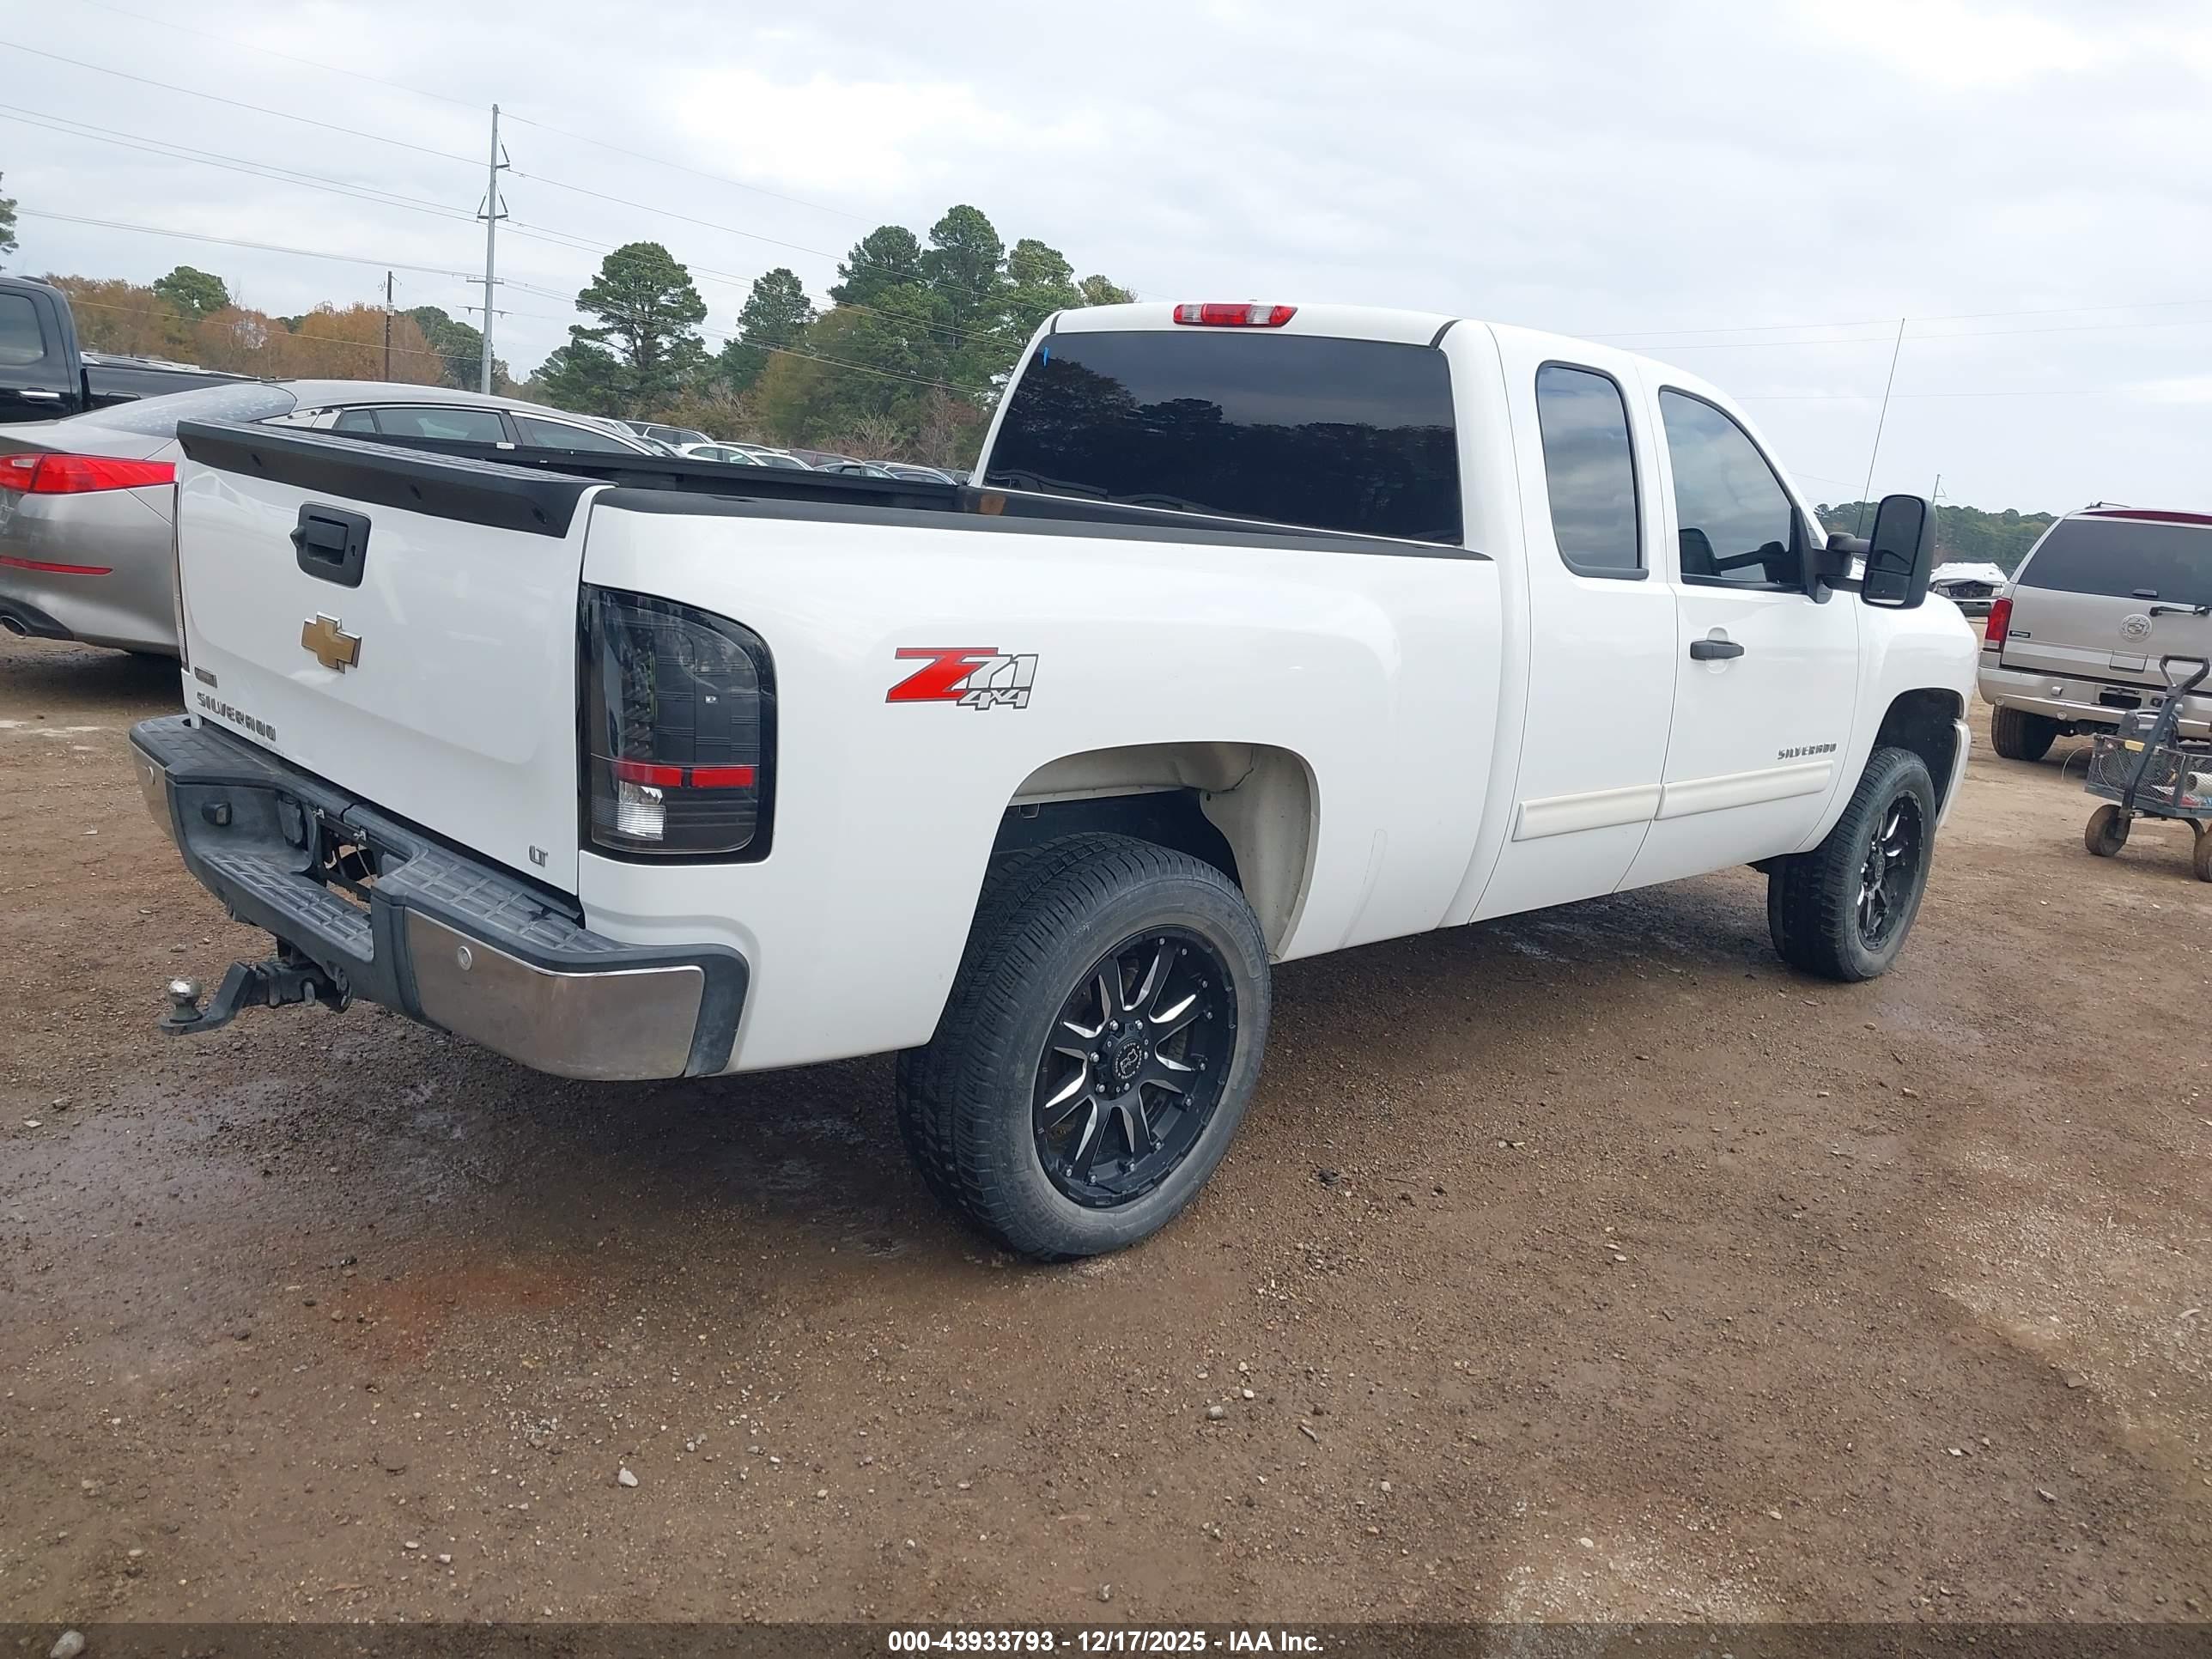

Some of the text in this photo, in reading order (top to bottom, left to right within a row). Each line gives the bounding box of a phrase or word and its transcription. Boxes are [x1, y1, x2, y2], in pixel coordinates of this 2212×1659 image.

[885, 647, 1038, 703] Z71
[197, 691, 276, 742] SILVERADO
[1777, 742, 1838, 760] SILVERADO
[529, 845, 549, 867] LT
